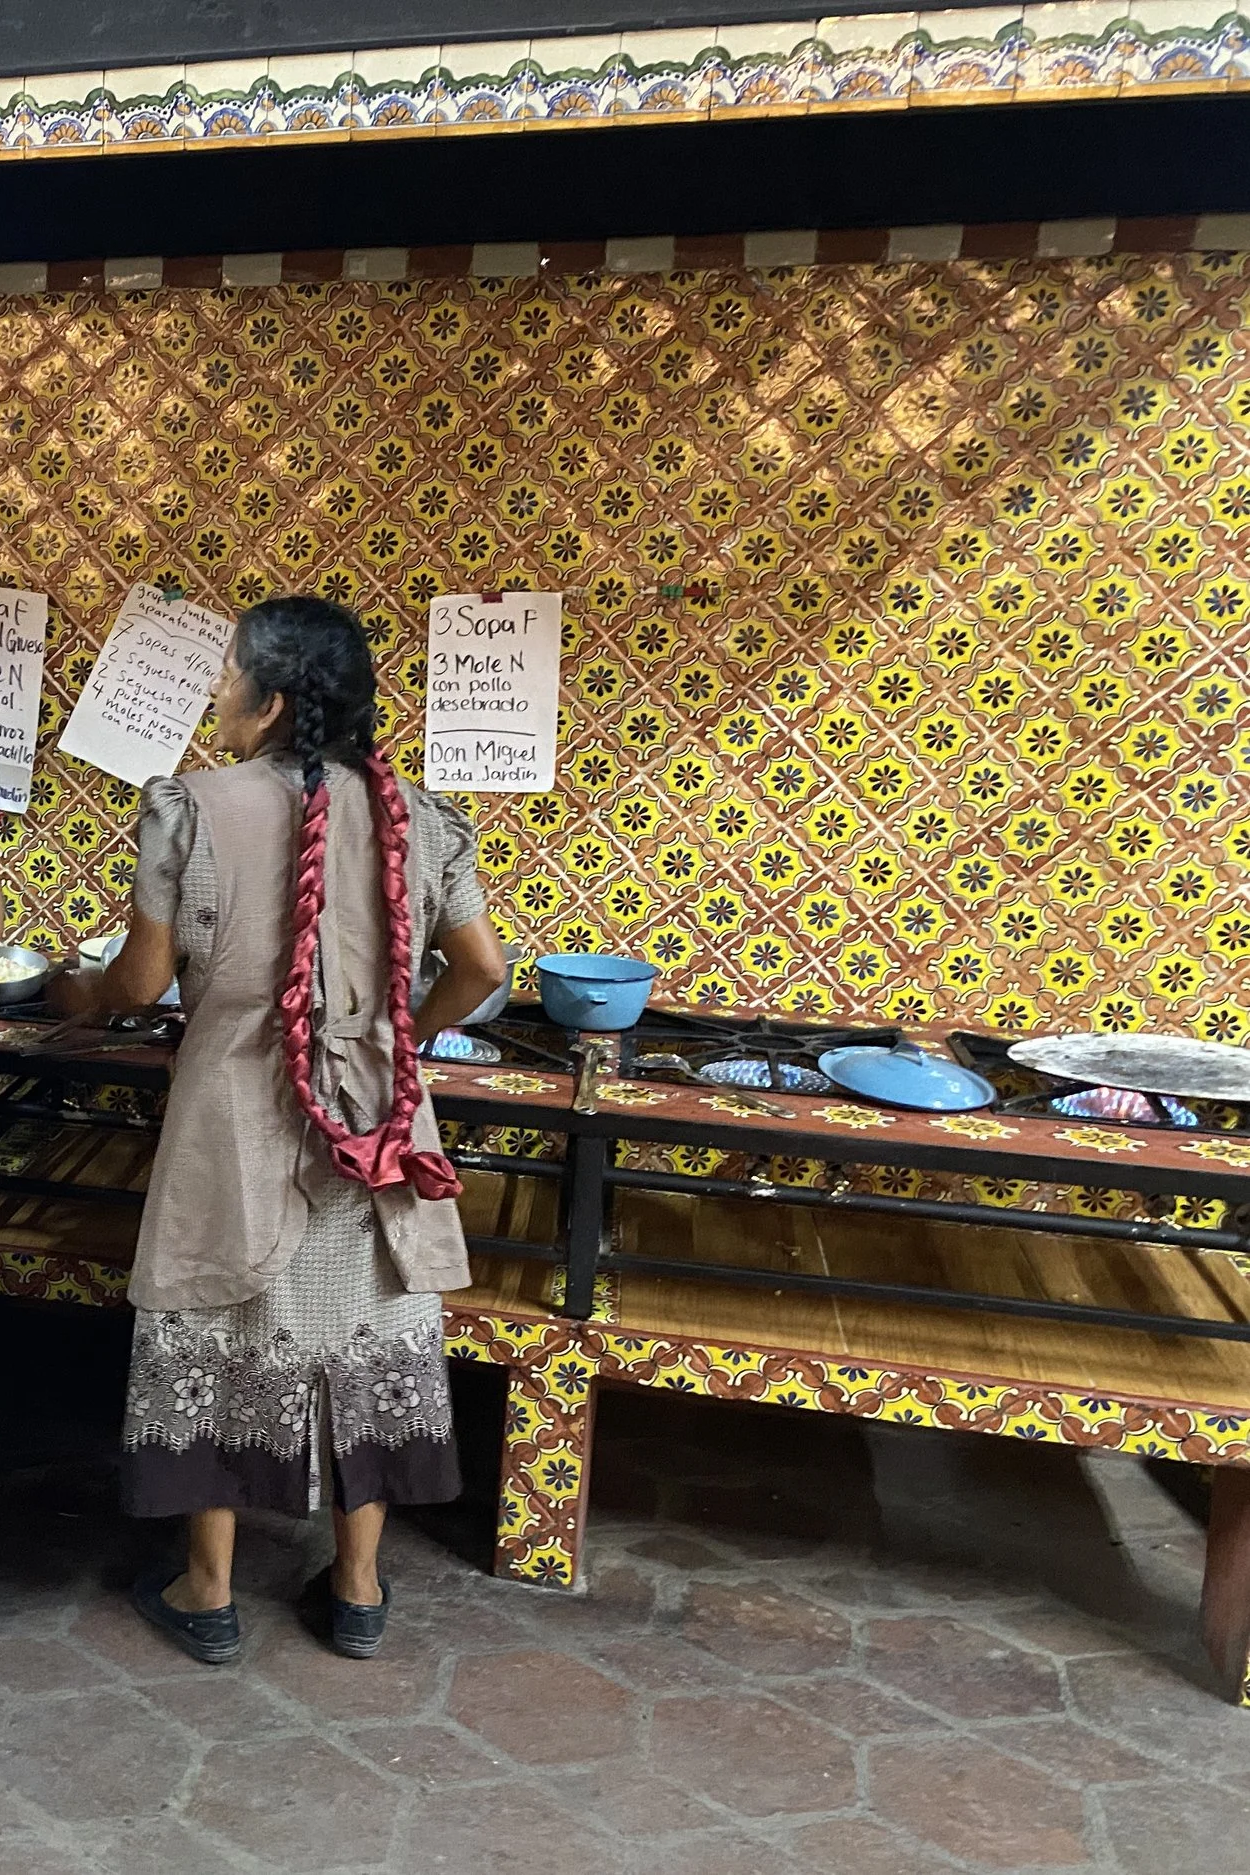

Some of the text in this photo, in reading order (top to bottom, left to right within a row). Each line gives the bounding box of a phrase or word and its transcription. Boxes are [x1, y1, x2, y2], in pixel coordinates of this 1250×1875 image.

[15, 598, 28, 626] F
[435, 605, 538, 640] 3 Sopa F
[108, 644, 120, 663] 2
[433, 650, 525, 676] 3 Mole N
[9, 663, 23, 692] N
[97, 662, 110, 679] 2
[92, 680, 104, 700] 4
[432, 677, 512, 696] con pollo
[431, 696, 529, 713] desebrado
[430, 740, 536, 766] Don Miguel
